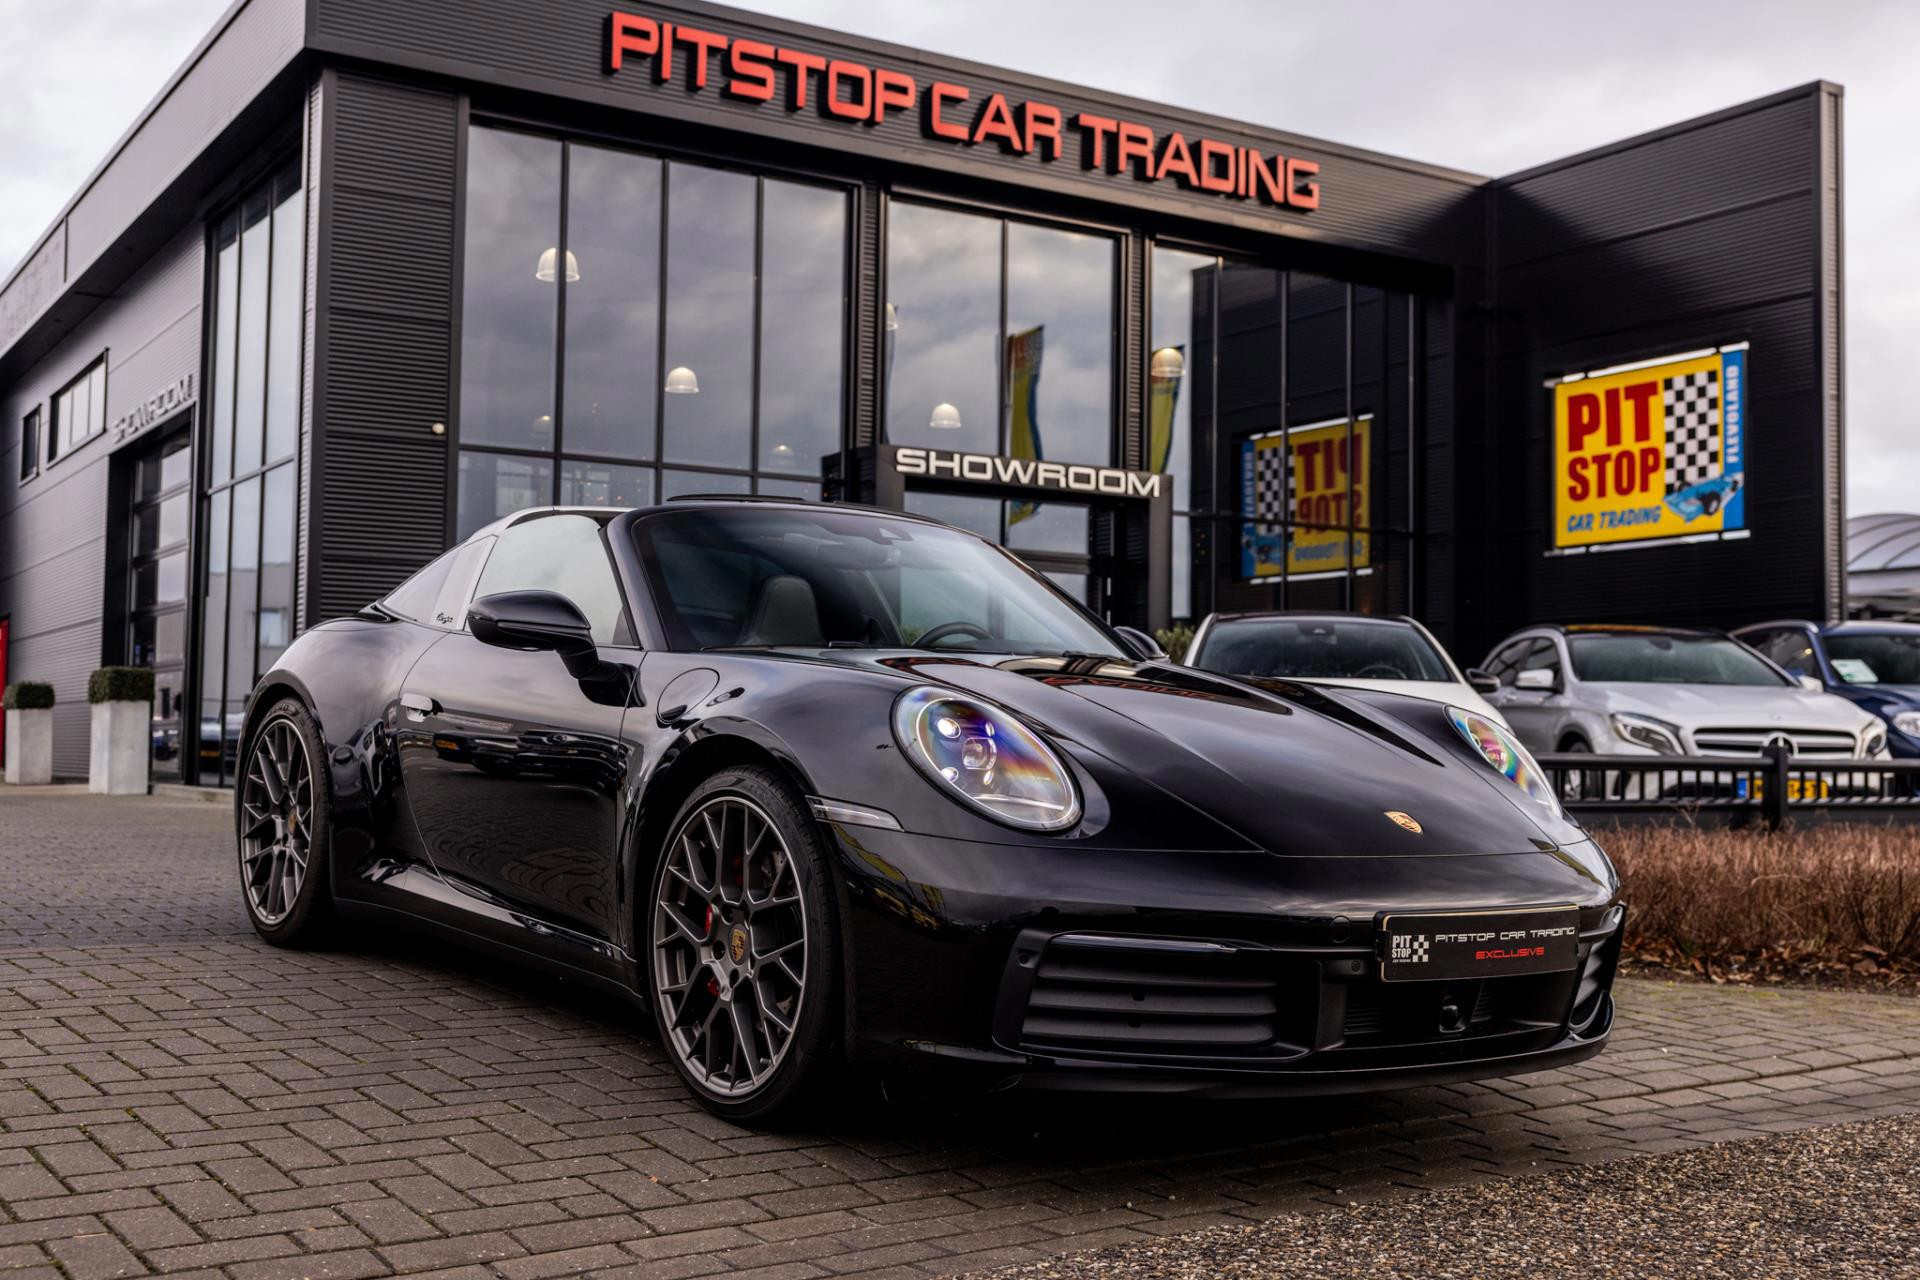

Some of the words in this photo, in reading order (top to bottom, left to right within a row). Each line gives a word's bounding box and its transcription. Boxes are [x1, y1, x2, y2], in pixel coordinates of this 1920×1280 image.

[609, 10, 916, 125] PITSTOP
[930, 81, 1062, 161] CAR
[1078, 112, 1321, 210] TRADING
[1567, 380, 1659, 452] PIT
[1726, 365, 1740, 464] FLEVOLAND
[895, 447, 1161, 498] SHOWROOM
[1567, 447, 1661, 502] STOP
[1567, 513, 1595, 533] CAR
[1600, 505, 1662, 530] TRADING
[1392, 935, 1412, 948] PIT
[1392, 948, 1411, 958] STOP
[1435, 931, 1495, 943] PITSTOP
[1500, 930, 1526, 941] CAR
[1530, 926, 1576, 938] TRADING
[1475, 946, 1545, 960] EXCLUSIVE
